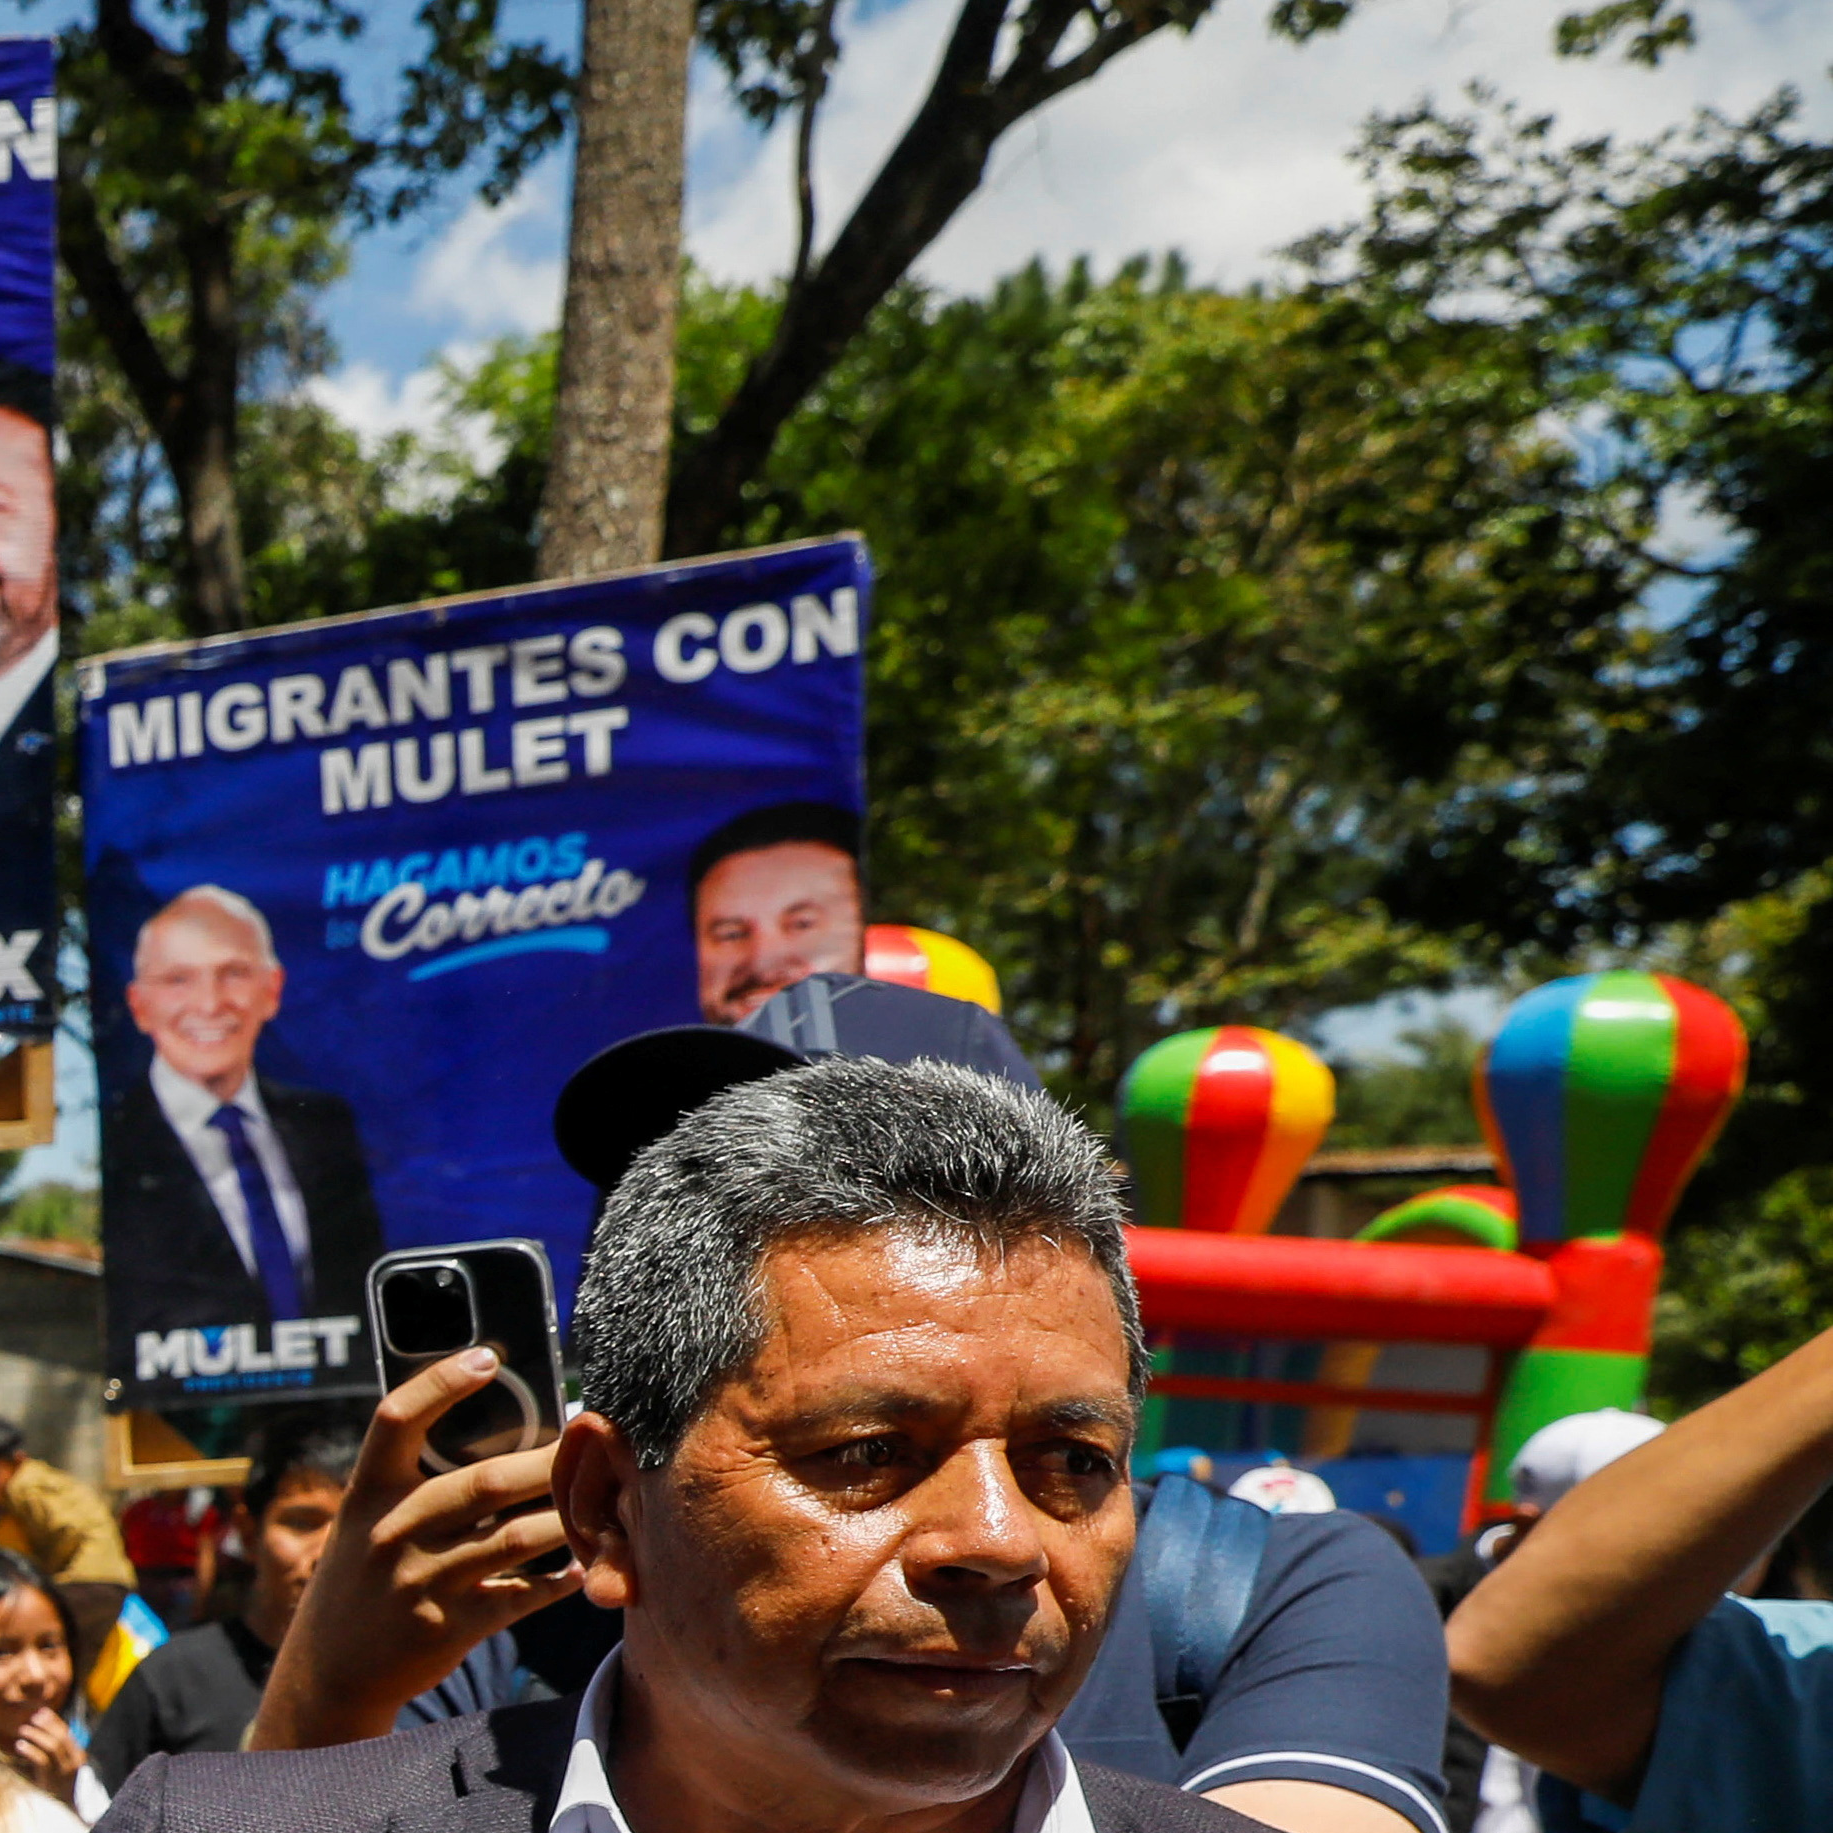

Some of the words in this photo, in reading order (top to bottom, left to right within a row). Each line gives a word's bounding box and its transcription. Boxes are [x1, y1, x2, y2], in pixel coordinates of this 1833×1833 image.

[108, 625, 626, 767] MIGRANTES
[653, 587, 858, 684] CON
[321, 706, 629, 815] MULET
[322, 831, 588, 908] HAGAMOS
[361, 858, 646, 961] Correcto
[135, 1315, 362, 1382] MULET
